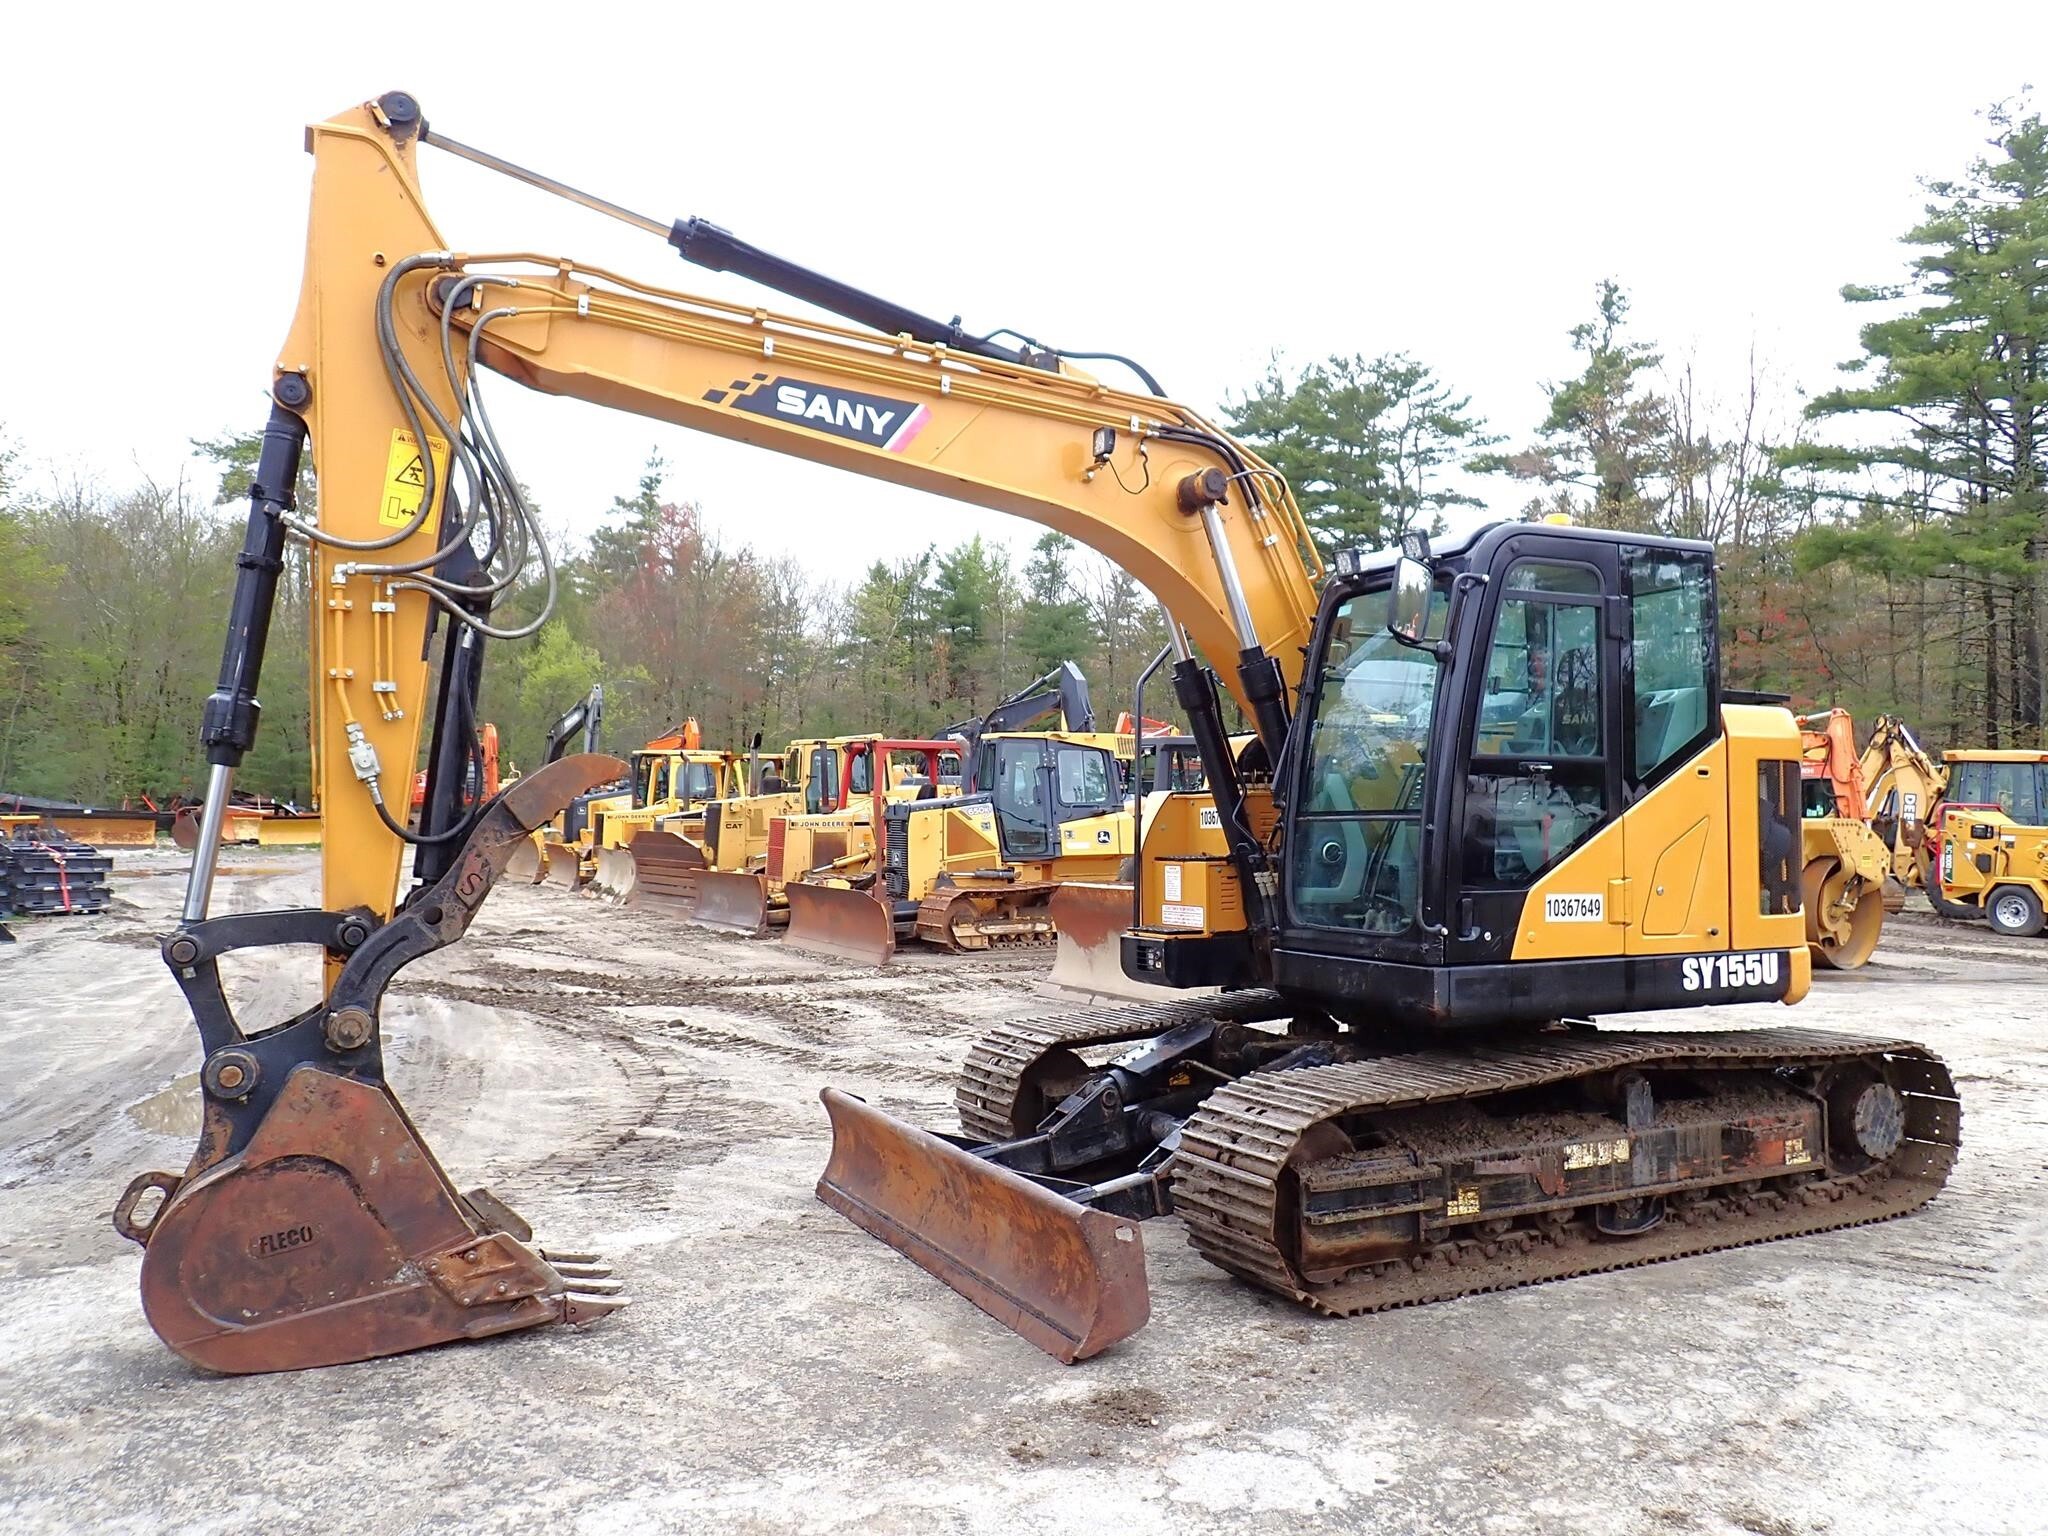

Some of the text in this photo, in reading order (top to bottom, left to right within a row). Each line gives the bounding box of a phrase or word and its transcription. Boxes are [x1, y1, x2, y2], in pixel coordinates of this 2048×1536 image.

[776, 385, 895, 436] SANY
[1546, 898, 1601, 918] 10367649
[1681, 953, 1779, 991] SY155U
[259, 1225, 314, 1253] FLECO
